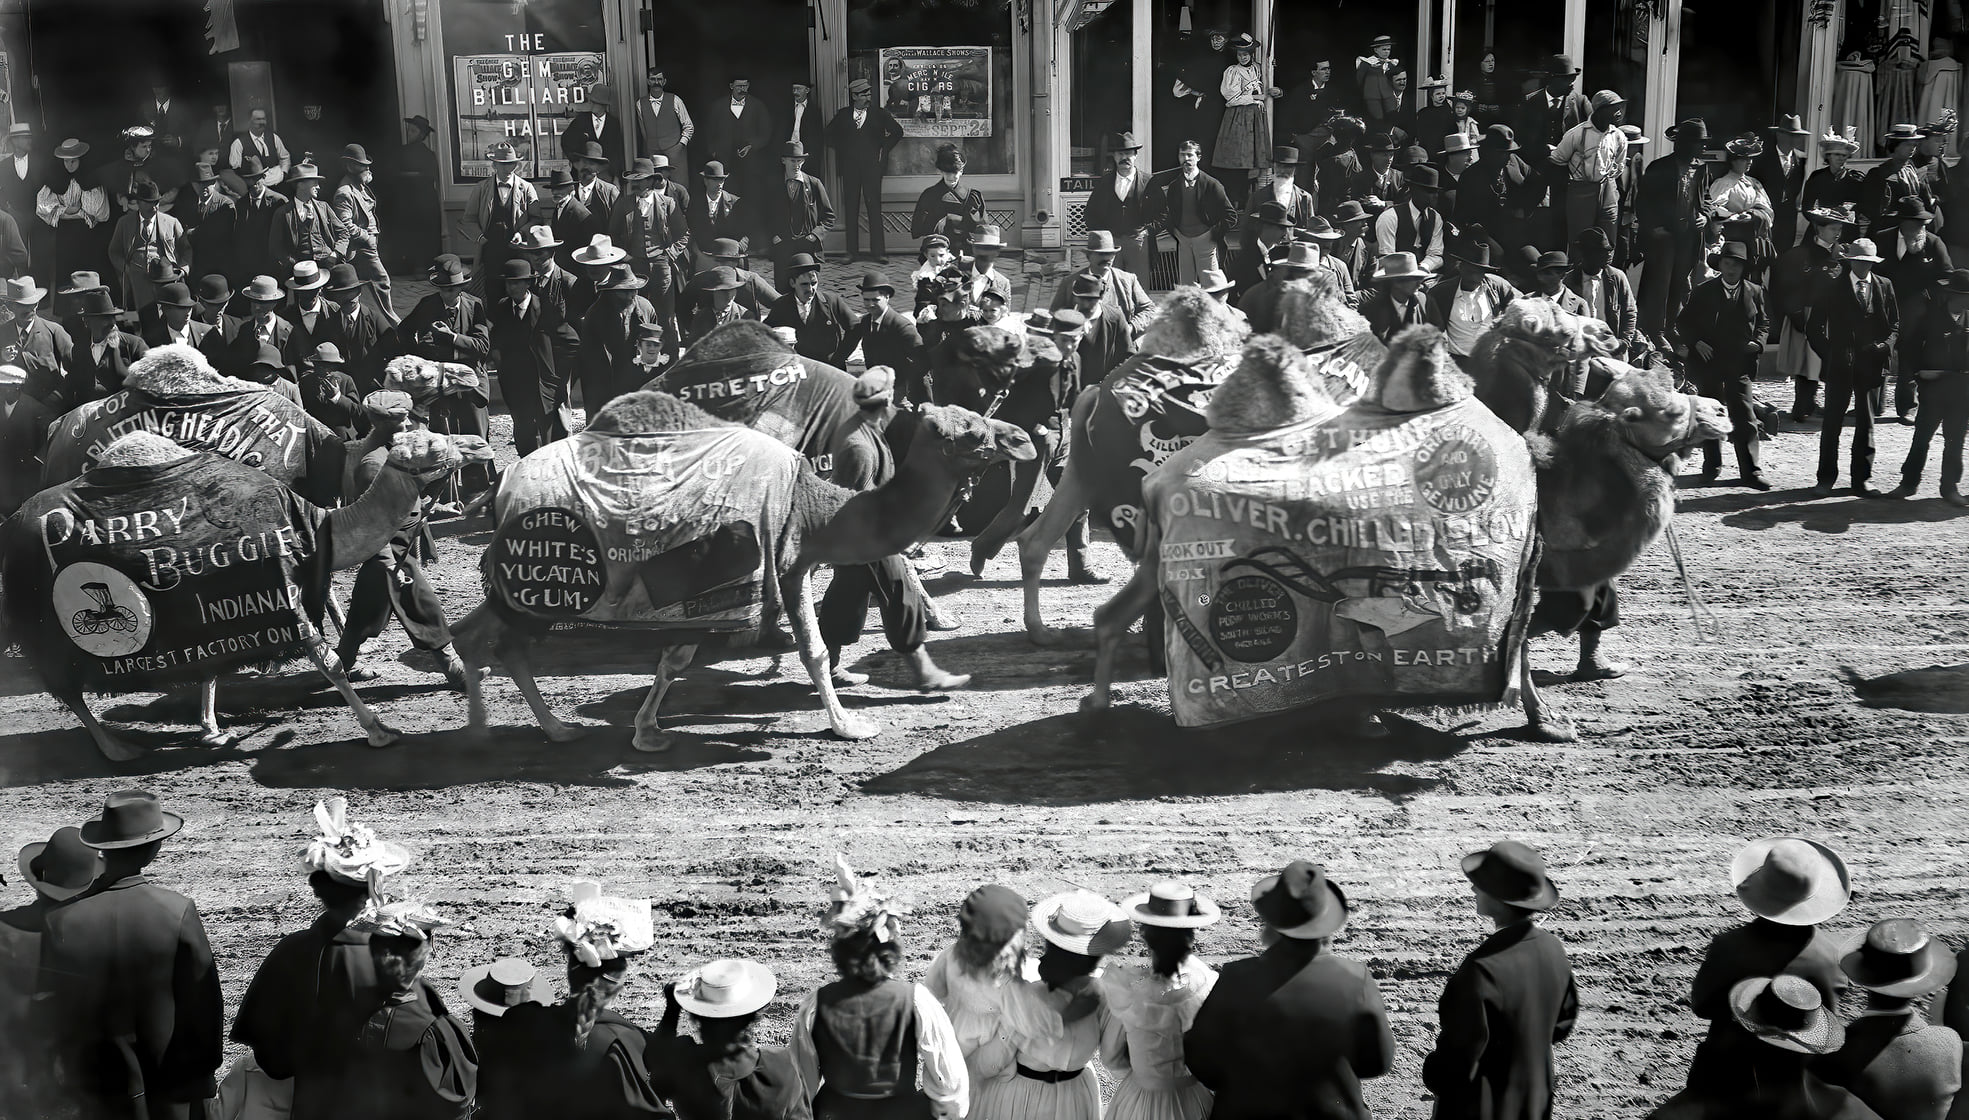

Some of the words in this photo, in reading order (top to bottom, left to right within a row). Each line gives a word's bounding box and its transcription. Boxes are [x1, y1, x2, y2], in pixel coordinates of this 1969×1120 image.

[505, 34, 545, 51] THE
[502, 61, 551, 78] GEM
[908, 82, 953, 91] CIGRS
[474, 87, 585, 106] BILLIARD
[505, 119, 564, 137] HALL
[970, 120, 988, 137] 24
[1064, 180, 1095, 190] TAIL
[680, 364, 807, 401] STRETCH
[71, 390, 130, 439] STOP
[250, 405, 306, 470] THAT
[1441, 450, 1468, 465] AND
[1287, 462, 1406, 501] BACKED
[1438, 470, 1472, 490] ONLY
[1349, 492, 1380, 510] USE
[1421, 473, 1494, 512] GENUINE
[38, 496, 187, 576] PARRY
[505, 539, 597, 565] WHITE'S
[1197, 541, 1225, 556] OUT
[500, 562, 600, 586] YUCATAN
[196, 584, 303, 625] INDIANAP
[102, 651, 180, 676] LARGEST
[184, 631, 261, 662] FACTORY
[267, 627, 293, 644] ON
[1354, 651, 1382, 662] ON
[1394, 648, 1499, 667] EARTH
